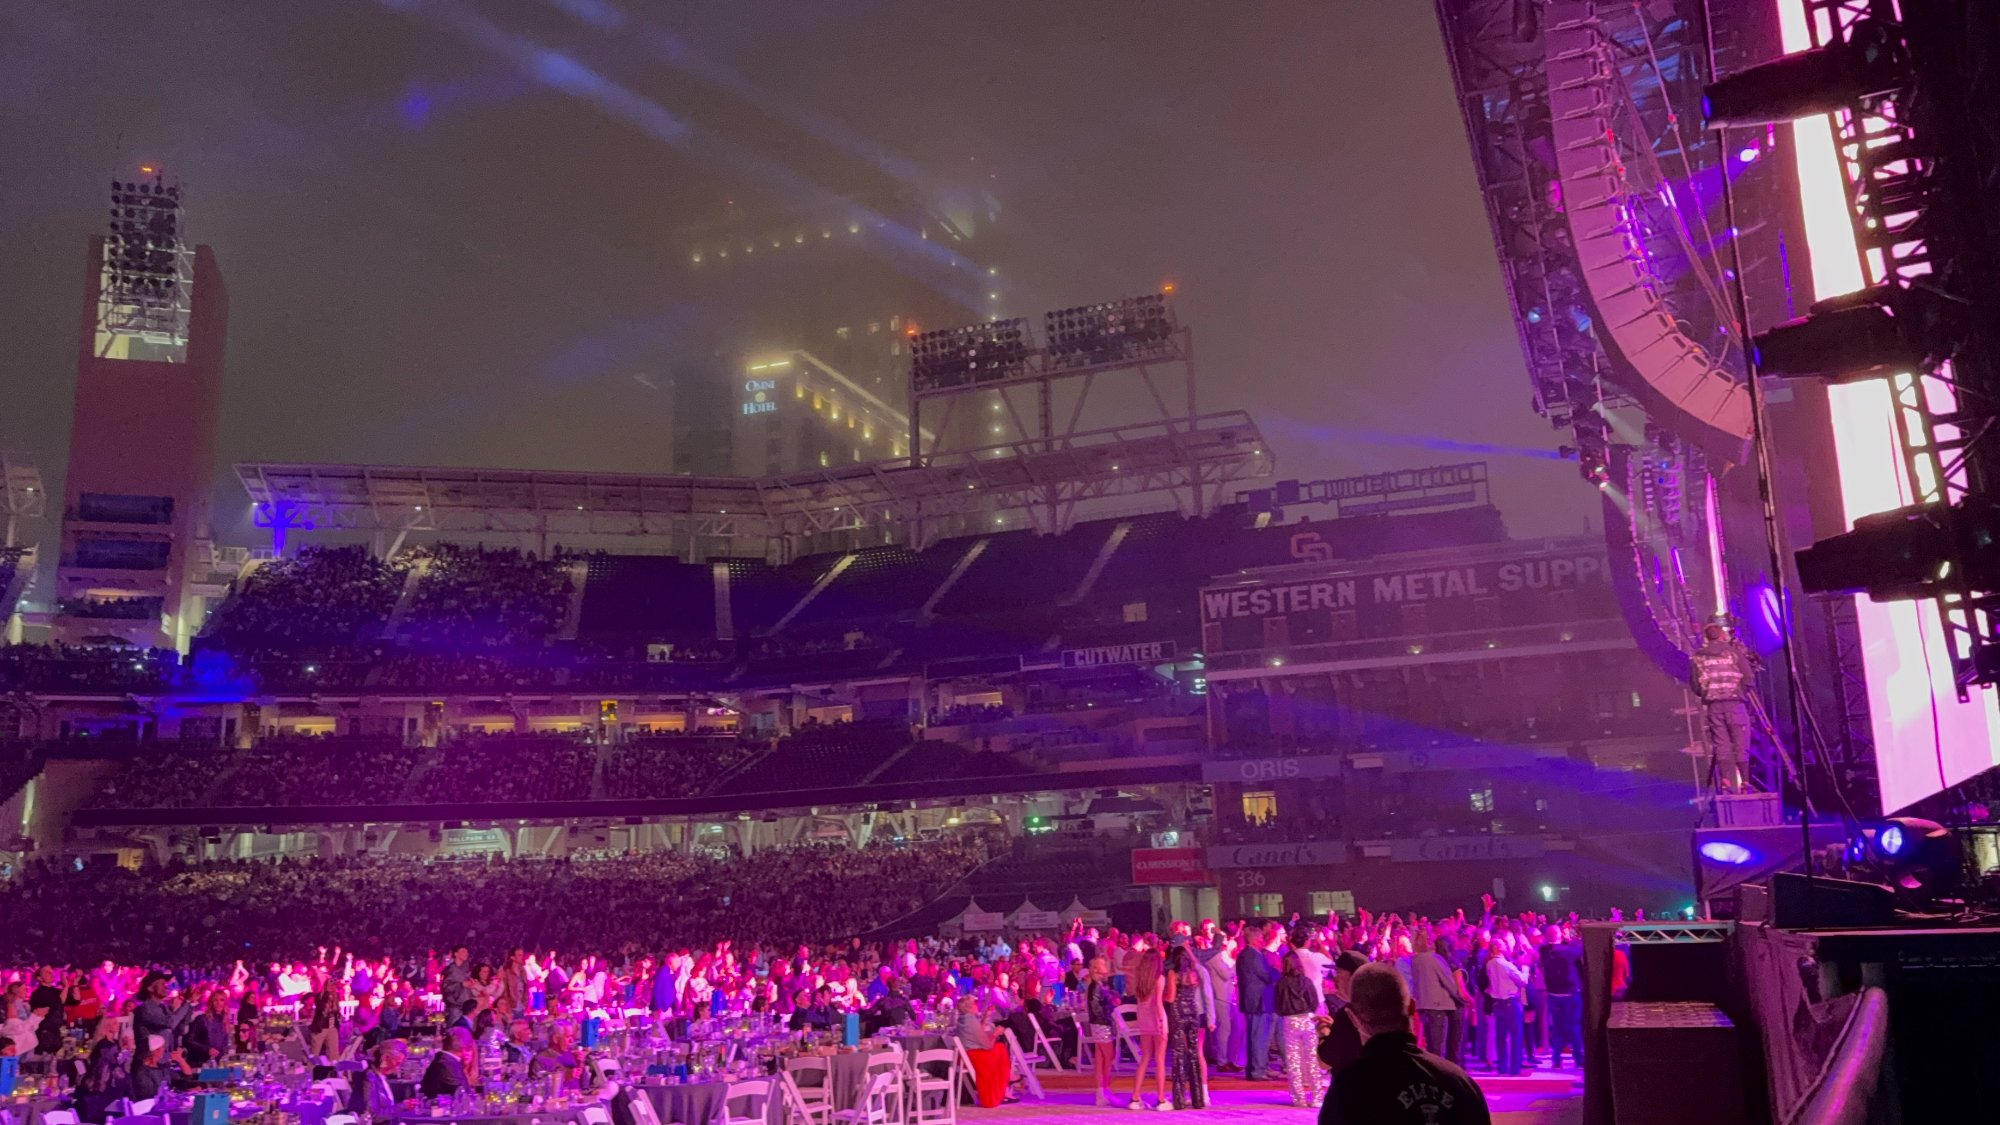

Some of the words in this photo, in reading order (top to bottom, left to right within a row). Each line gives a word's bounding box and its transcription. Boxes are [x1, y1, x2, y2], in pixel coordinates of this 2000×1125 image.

[1205, 580, 1356, 619] WESTERN
[1373, 566, 1488, 604] METAL
[1074, 642, 1161, 666] CUTWATER
[1240, 758, 1300, 779] ORIS
[1237, 870, 1266, 888] 336
